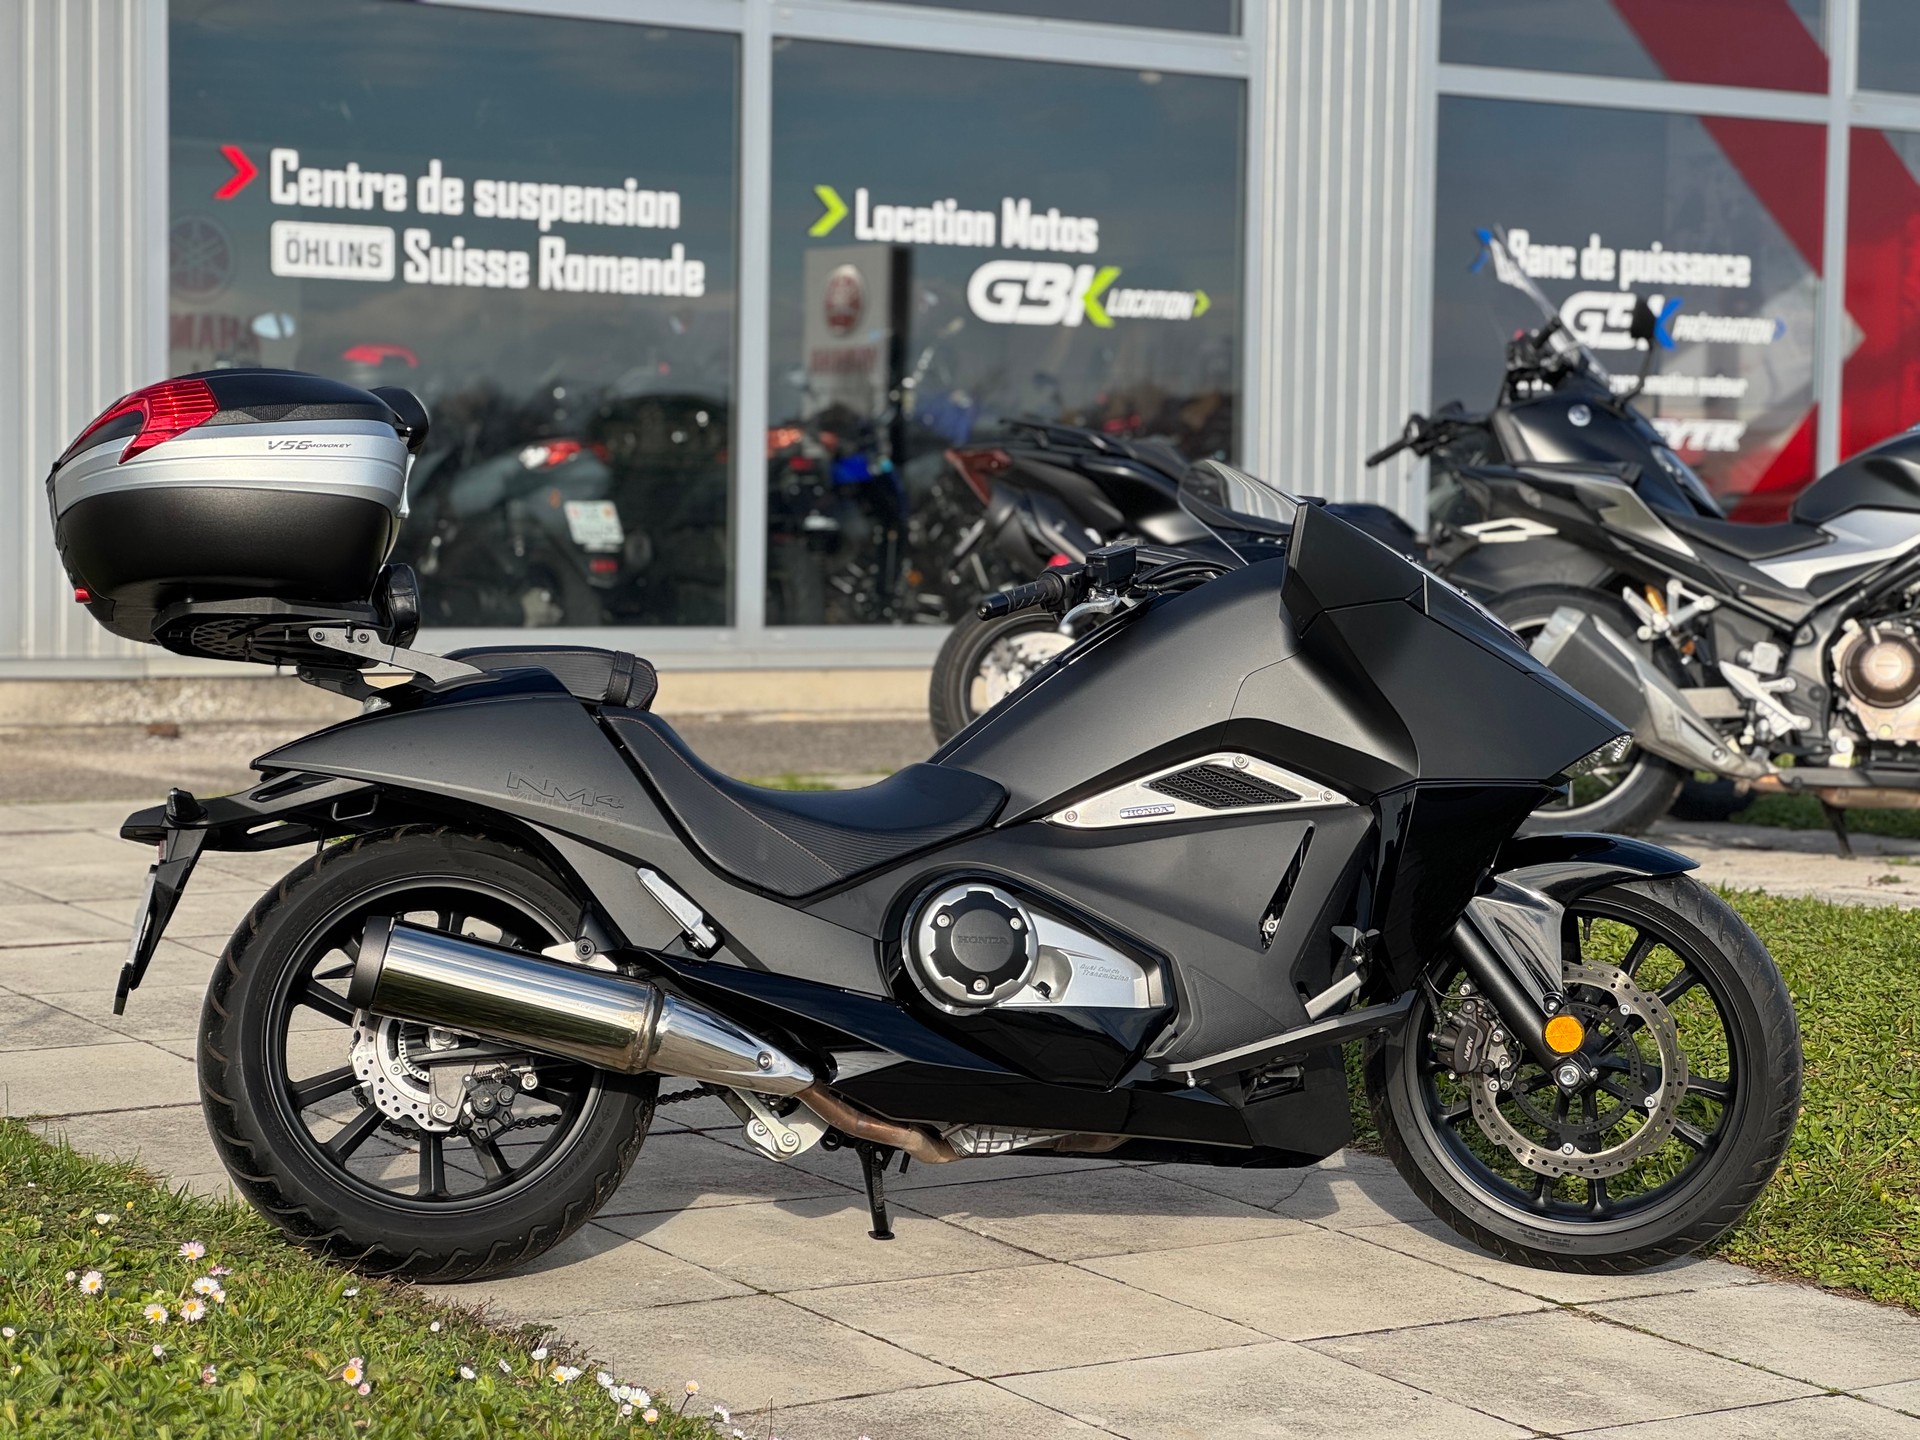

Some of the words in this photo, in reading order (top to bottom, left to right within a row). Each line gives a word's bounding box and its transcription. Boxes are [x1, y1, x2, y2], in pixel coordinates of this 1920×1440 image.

[270, 148, 407, 212] Centre
[417, 159, 464, 216] de
[474, 178, 681, 232] suspension
[855, 188, 996, 247] Location
[1002, 197, 1099, 254] Motos
[285, 230, 383, 269] ÖHLINS
[403, 228, 530, 289] Suisse
[539, 235, 705, 297] Romande
[1580, 233, 1615, 281] de
[1619, 241, 1751, 292] puissance
[967, 259, 1122, 328] GBK
[1106, 288, 1196, 320] LOCATION
[268, 440, 312, 451] V56
[507, 771, 624, 809] NM4
[1127, 806, 1170, 816] HONDA
[957, 935, 1009, 945] HONDA
